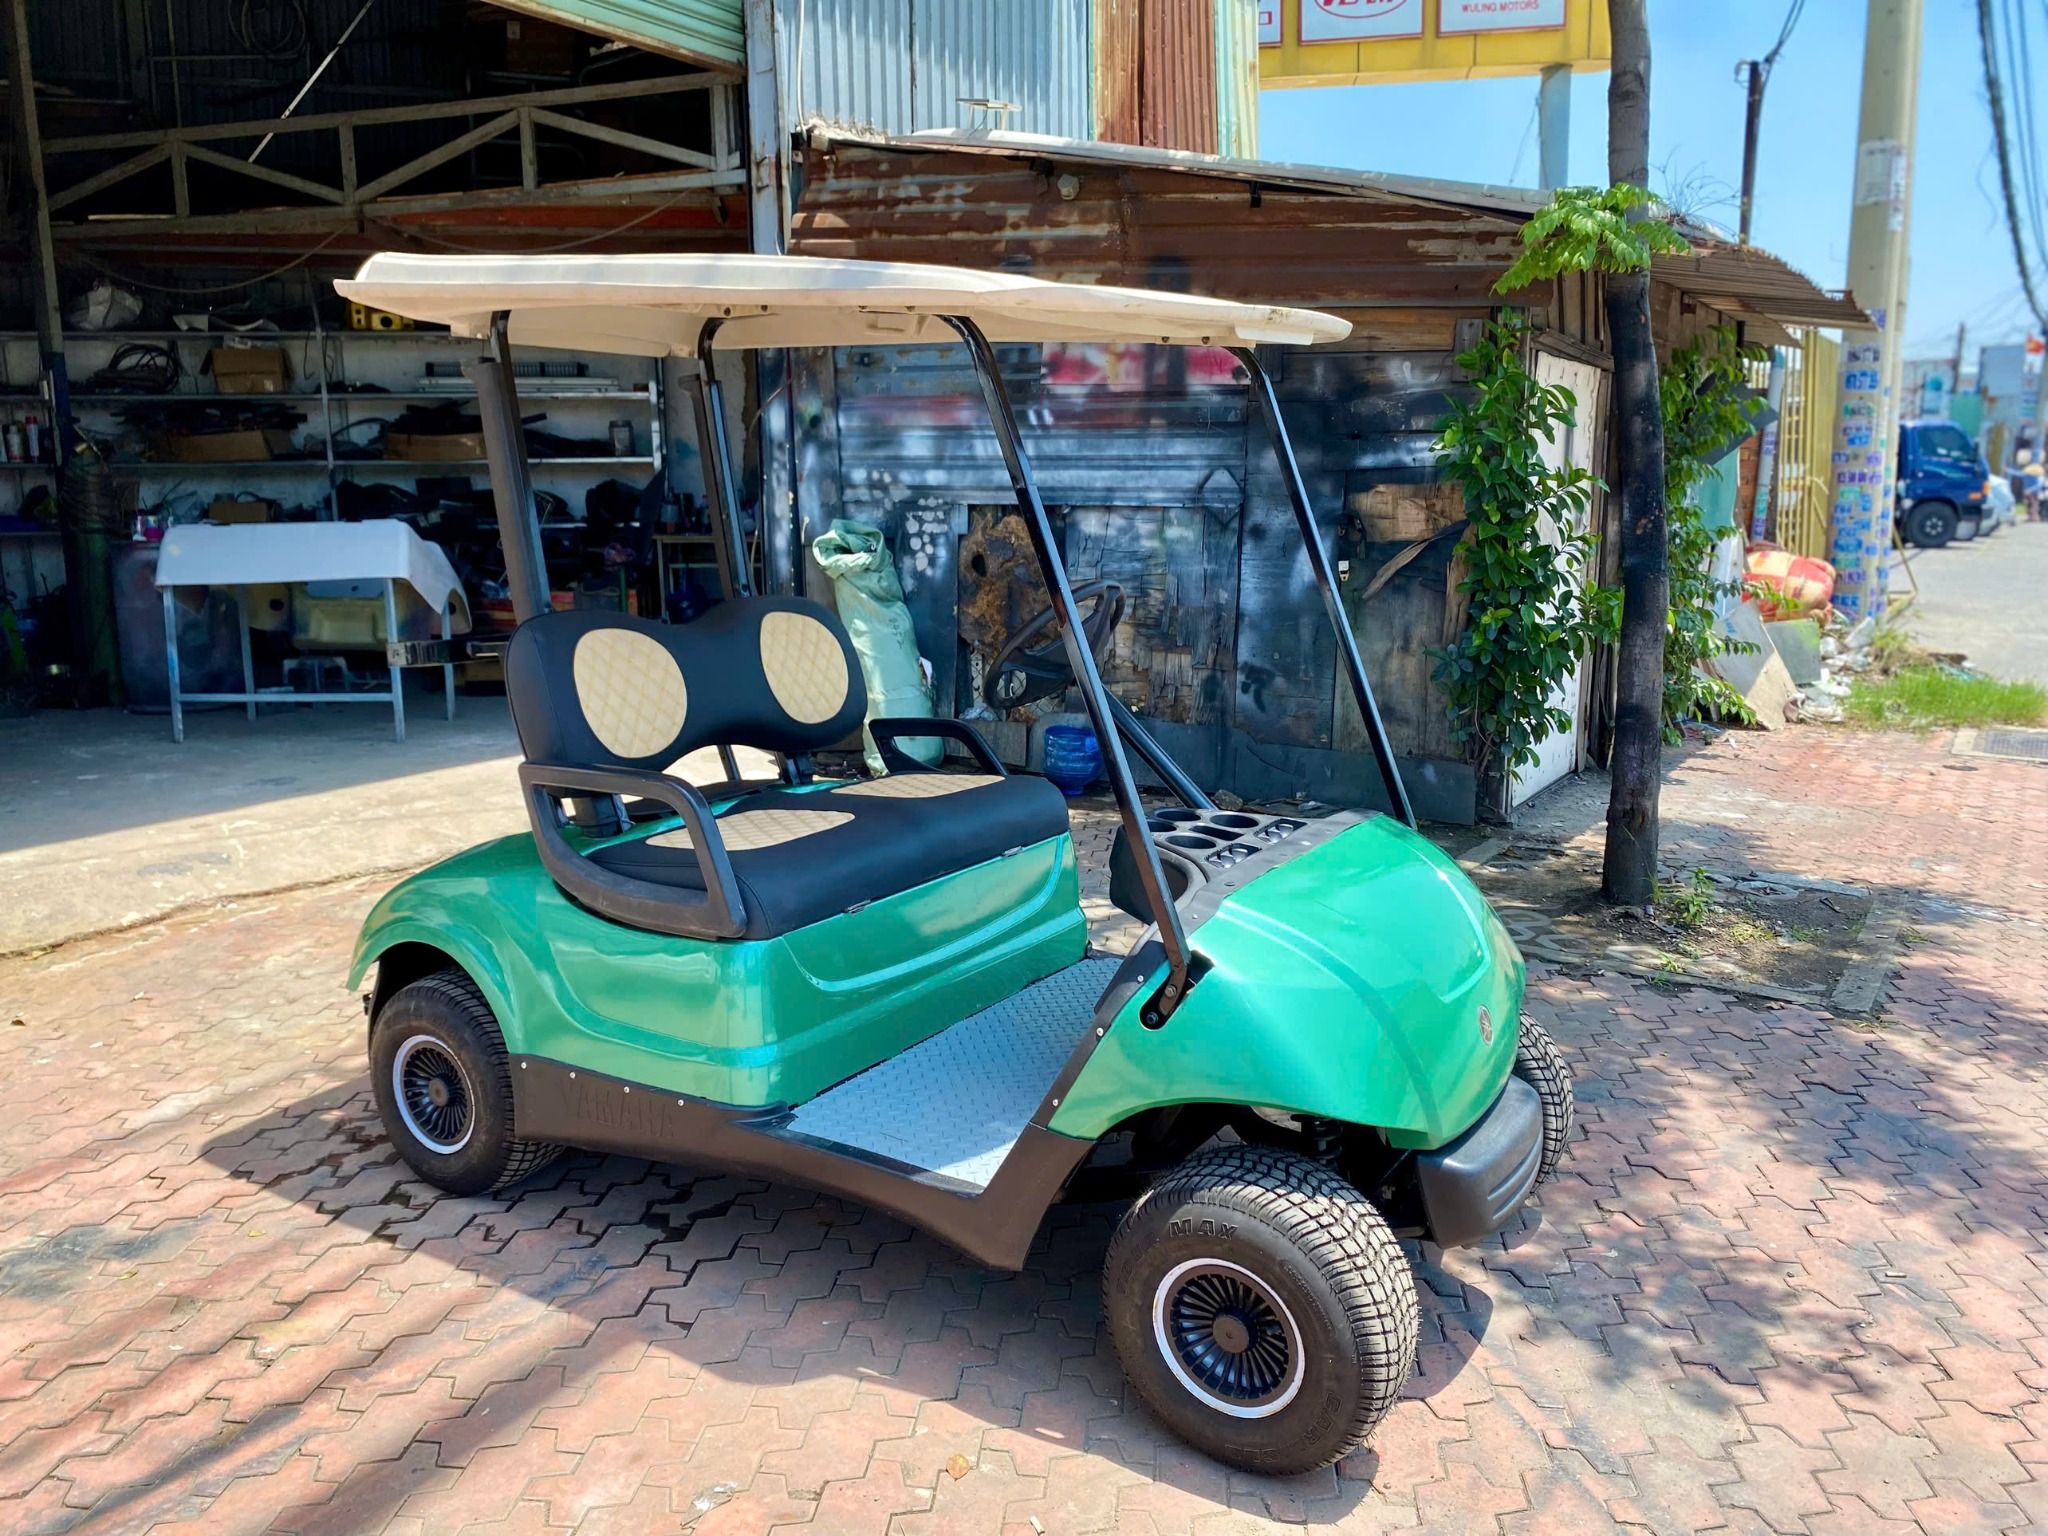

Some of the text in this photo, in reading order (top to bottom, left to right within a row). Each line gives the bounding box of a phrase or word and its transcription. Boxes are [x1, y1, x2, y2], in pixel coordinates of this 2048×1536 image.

[1462, 0, 1539, 13] WULING MOTORS
[1168, 1216, 1239, 1241] MAX
